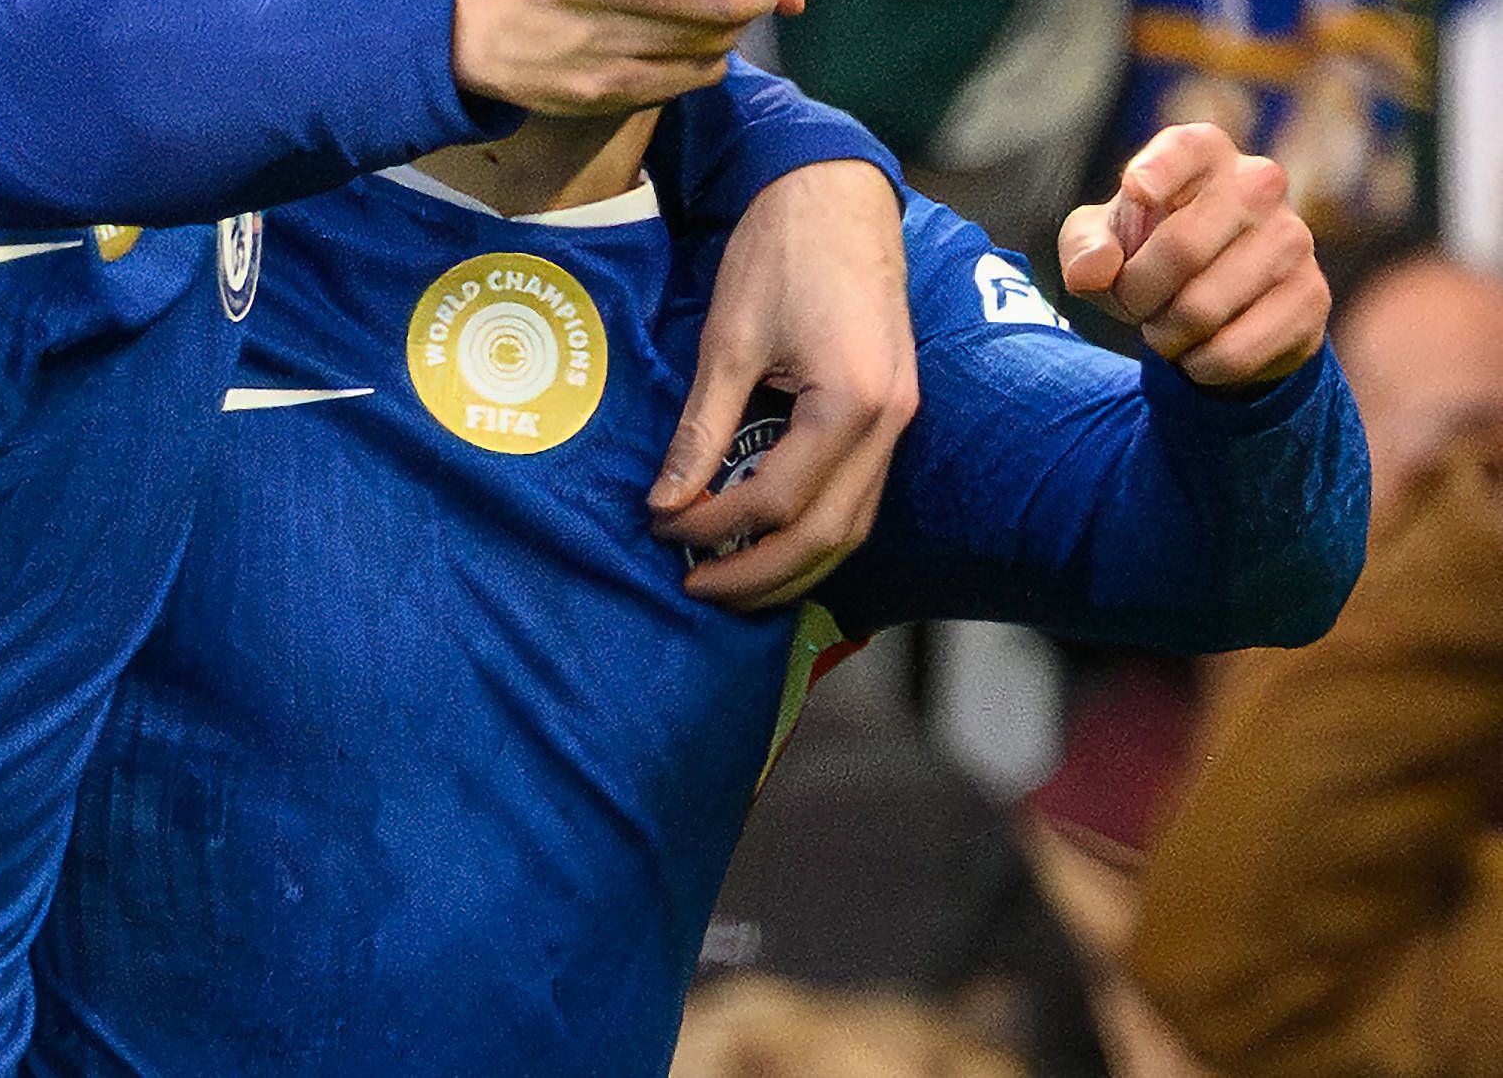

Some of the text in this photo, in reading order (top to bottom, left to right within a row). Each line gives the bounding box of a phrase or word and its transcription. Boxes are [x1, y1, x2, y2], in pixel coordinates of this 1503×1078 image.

[427, 269, 592, 387] WORLD CHAMPIONS
[465, 404, 541, 438] FIFA
